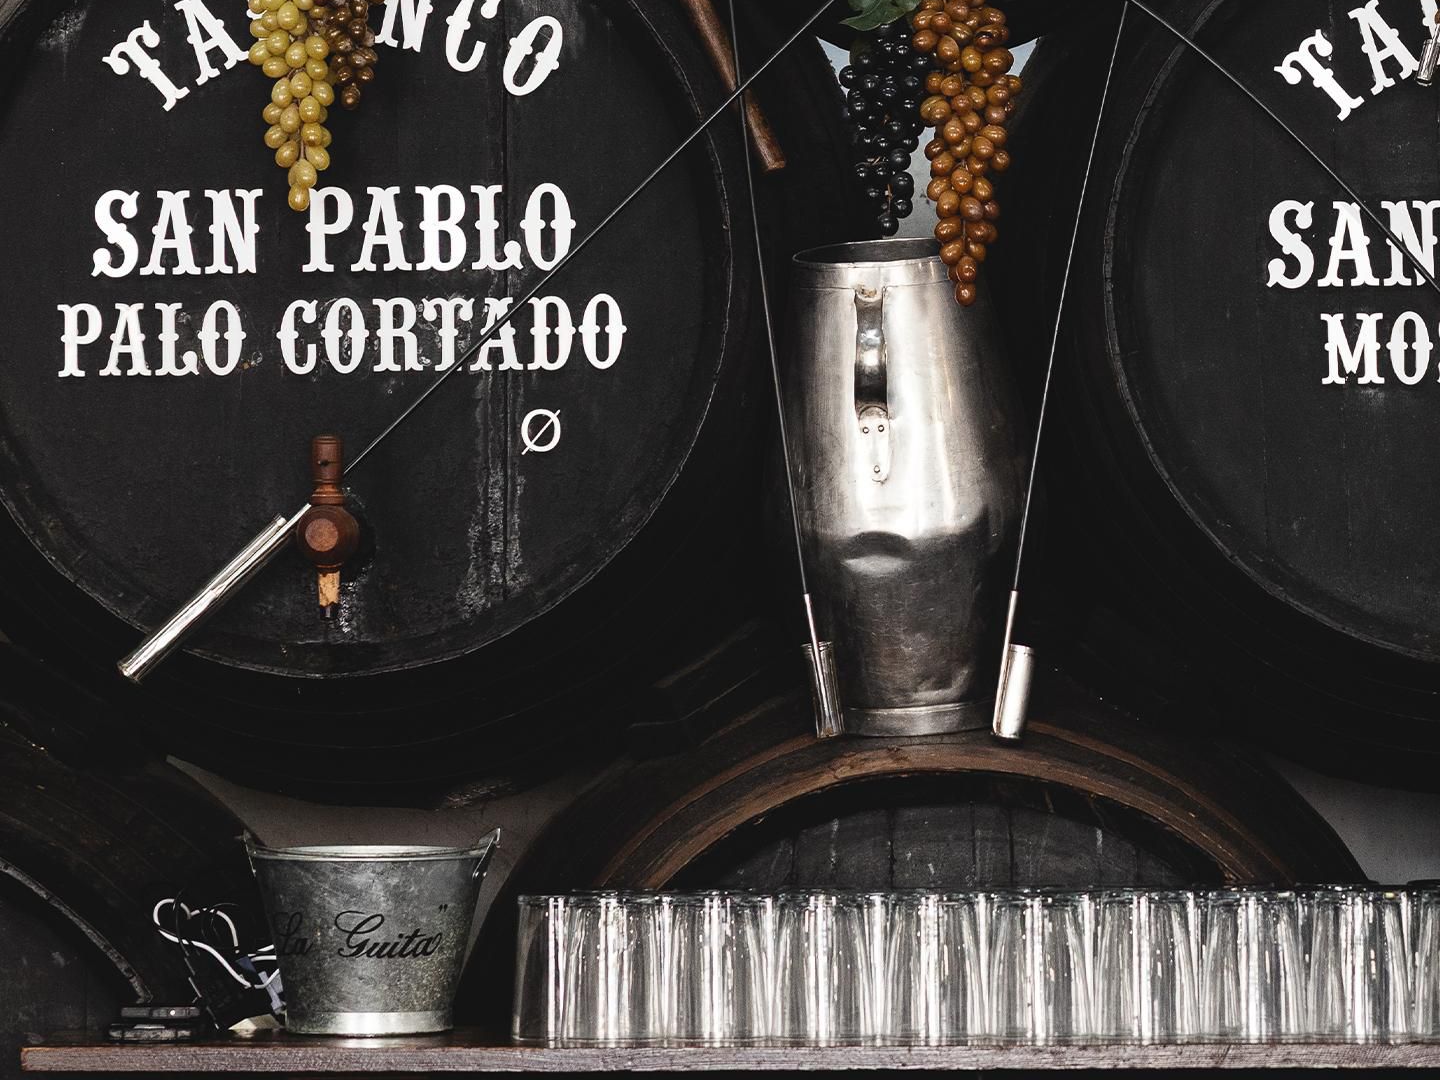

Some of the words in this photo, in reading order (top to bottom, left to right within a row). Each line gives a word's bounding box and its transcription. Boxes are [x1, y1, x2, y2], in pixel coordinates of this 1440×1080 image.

[91, 188, 264, 278] SAN
[301, 182, 577, 274] PABLO
[1266, 199, 1440, 289] SAN
[57, 299, 247, 378] PALO
[275, 292, 628, 375] CORTADO
